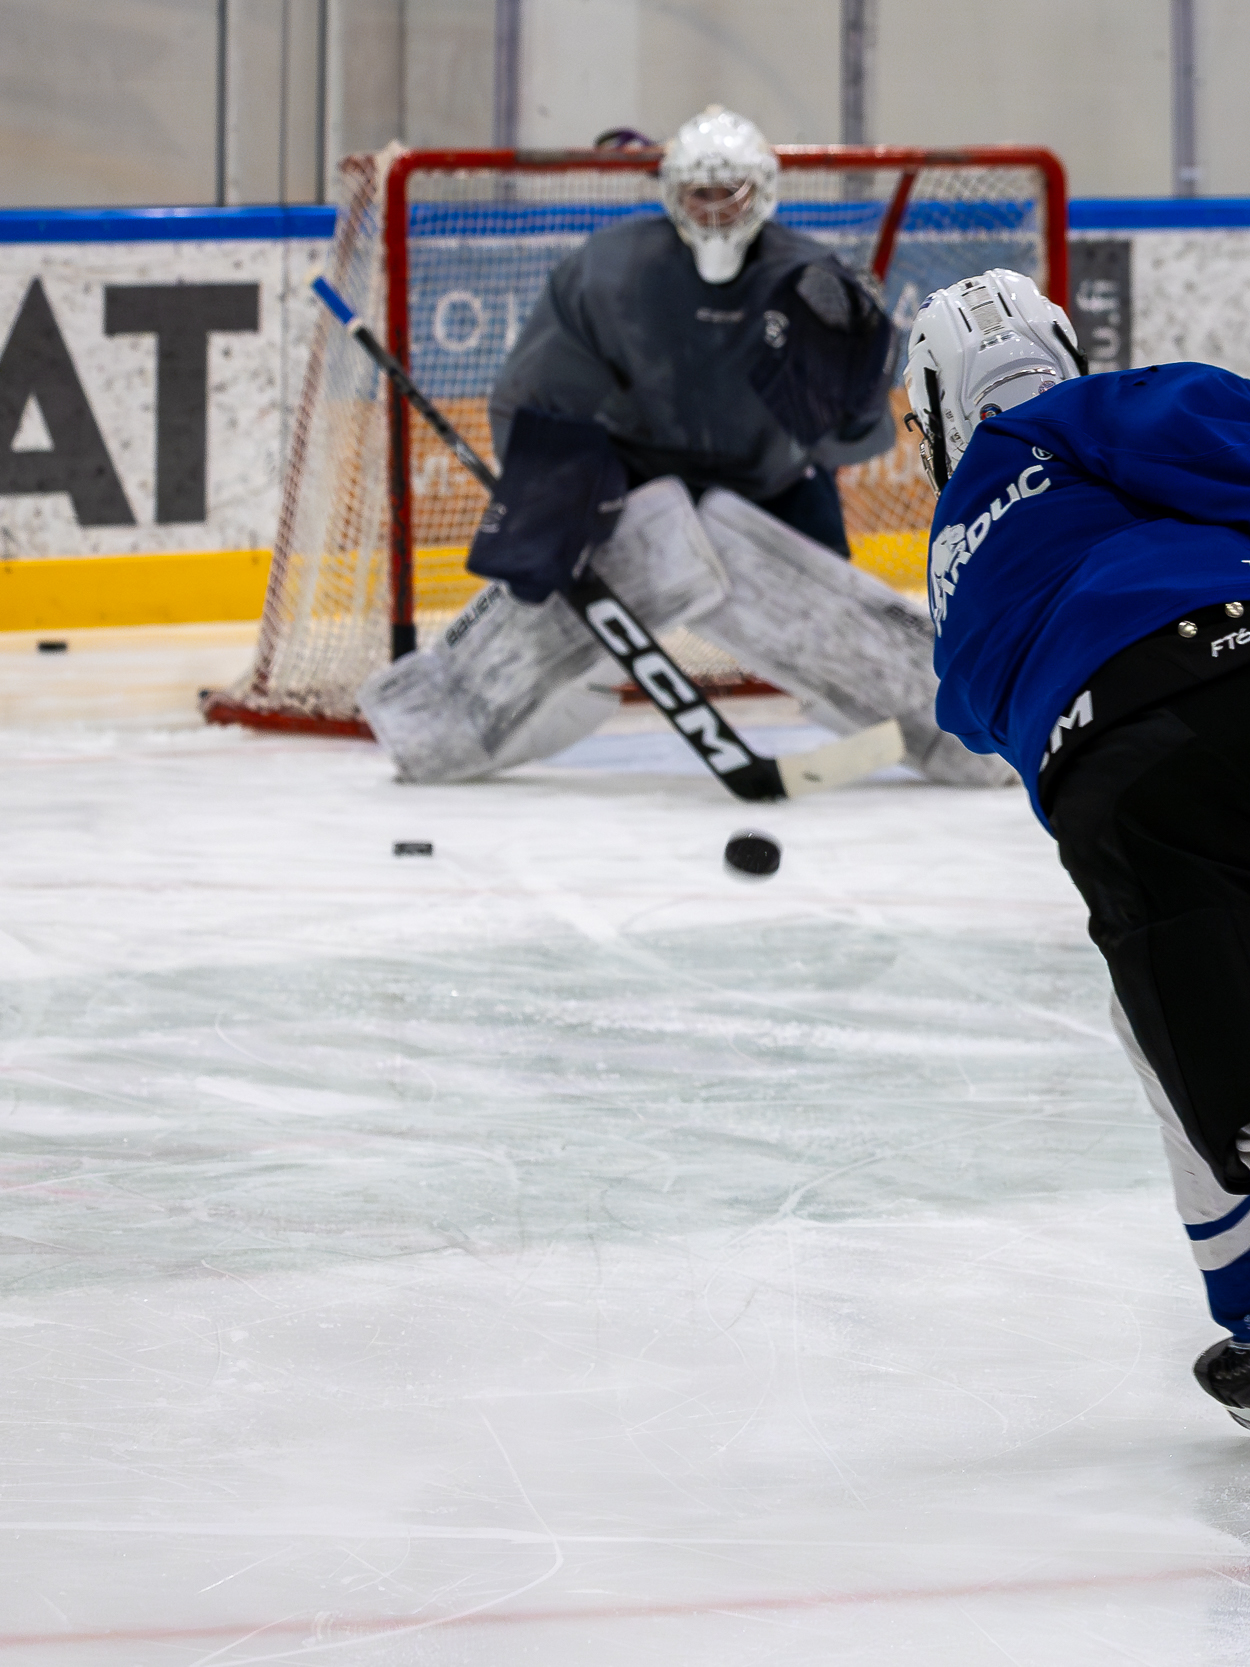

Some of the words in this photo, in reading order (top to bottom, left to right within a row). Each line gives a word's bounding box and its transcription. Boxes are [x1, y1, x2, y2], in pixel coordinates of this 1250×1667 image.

[0, 276, 260, 528] AT
[1076, 280, 1120, 373] u.fi
[585, 598, 751, 776] CCM
